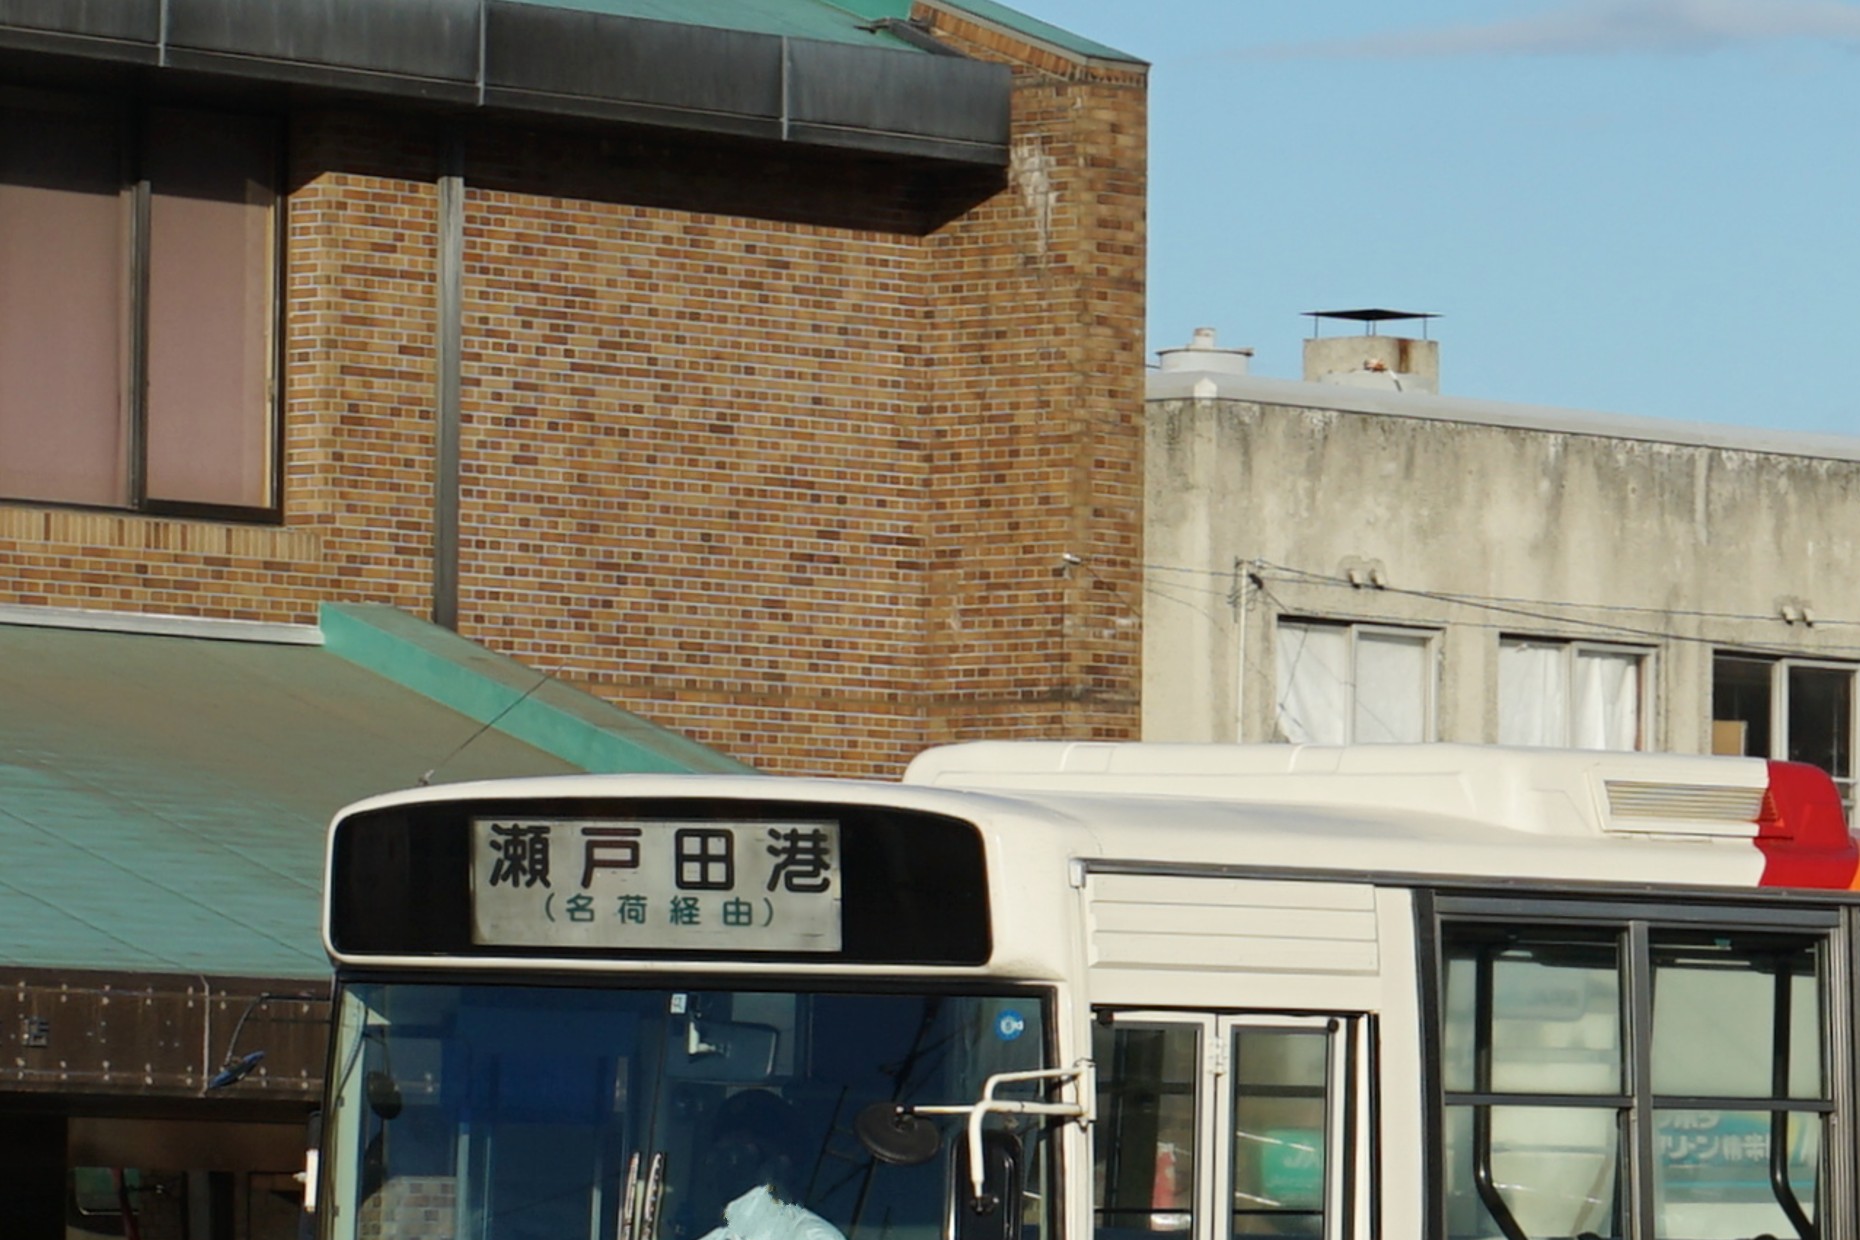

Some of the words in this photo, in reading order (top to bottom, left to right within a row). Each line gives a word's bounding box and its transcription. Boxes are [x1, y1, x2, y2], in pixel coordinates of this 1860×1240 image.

[489, 823, 831, 893] 瀬戸田港
[545, 892, 773, 928] (名荷経由)
